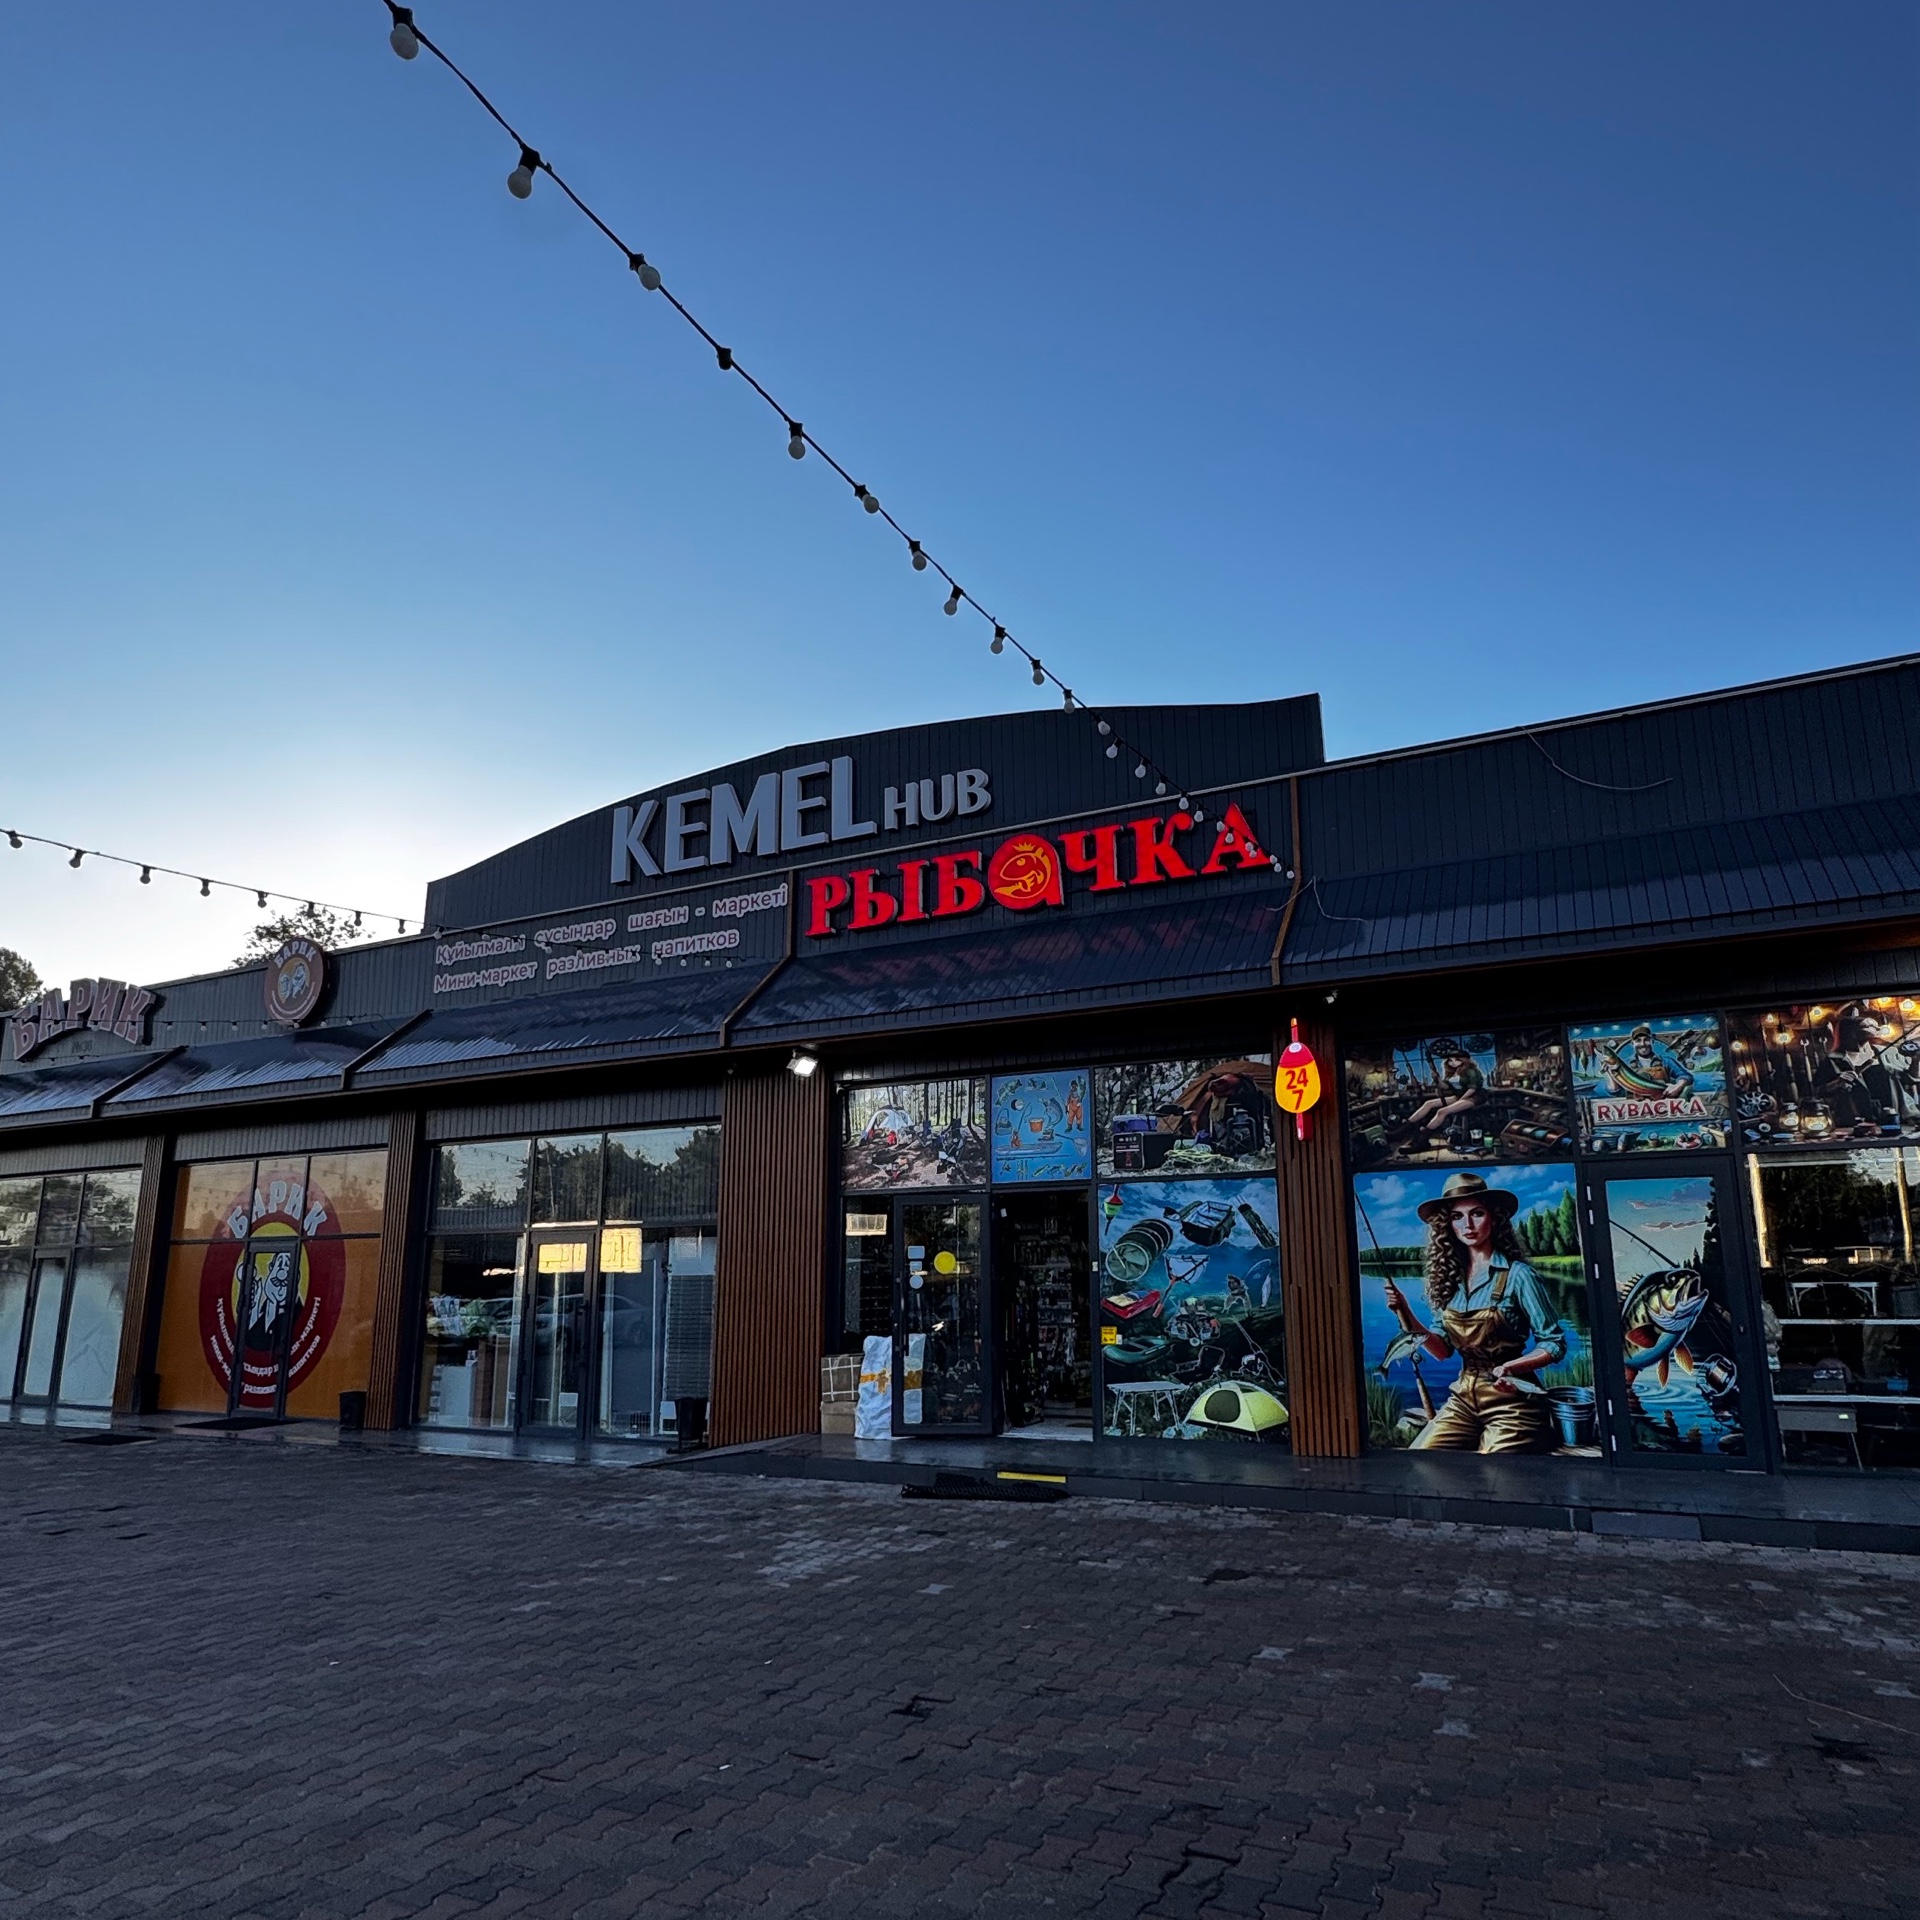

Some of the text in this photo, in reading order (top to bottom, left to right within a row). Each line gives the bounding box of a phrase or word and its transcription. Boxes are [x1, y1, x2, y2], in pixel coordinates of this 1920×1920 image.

[610, 756, 993, 884] KEMEL HUB
[534, 918, 616, 950] сусындар
[628, 906, 689, 932] шағын
[713, 883, 788, 918] маркеті
[274, 940, 317, 969] БАРИК
[434, 928, 740, 994] Мини-маркет разливных напитков
[11, 977, 157, 1061] БАРИК
[1285, 1068, 1309, 1090] 24
[1292, 1089, 1304, 1110] 7
[1596, 1097, 1707, 1122] RYBACKA
[227, 1180, 328, 1239] БАРИК
